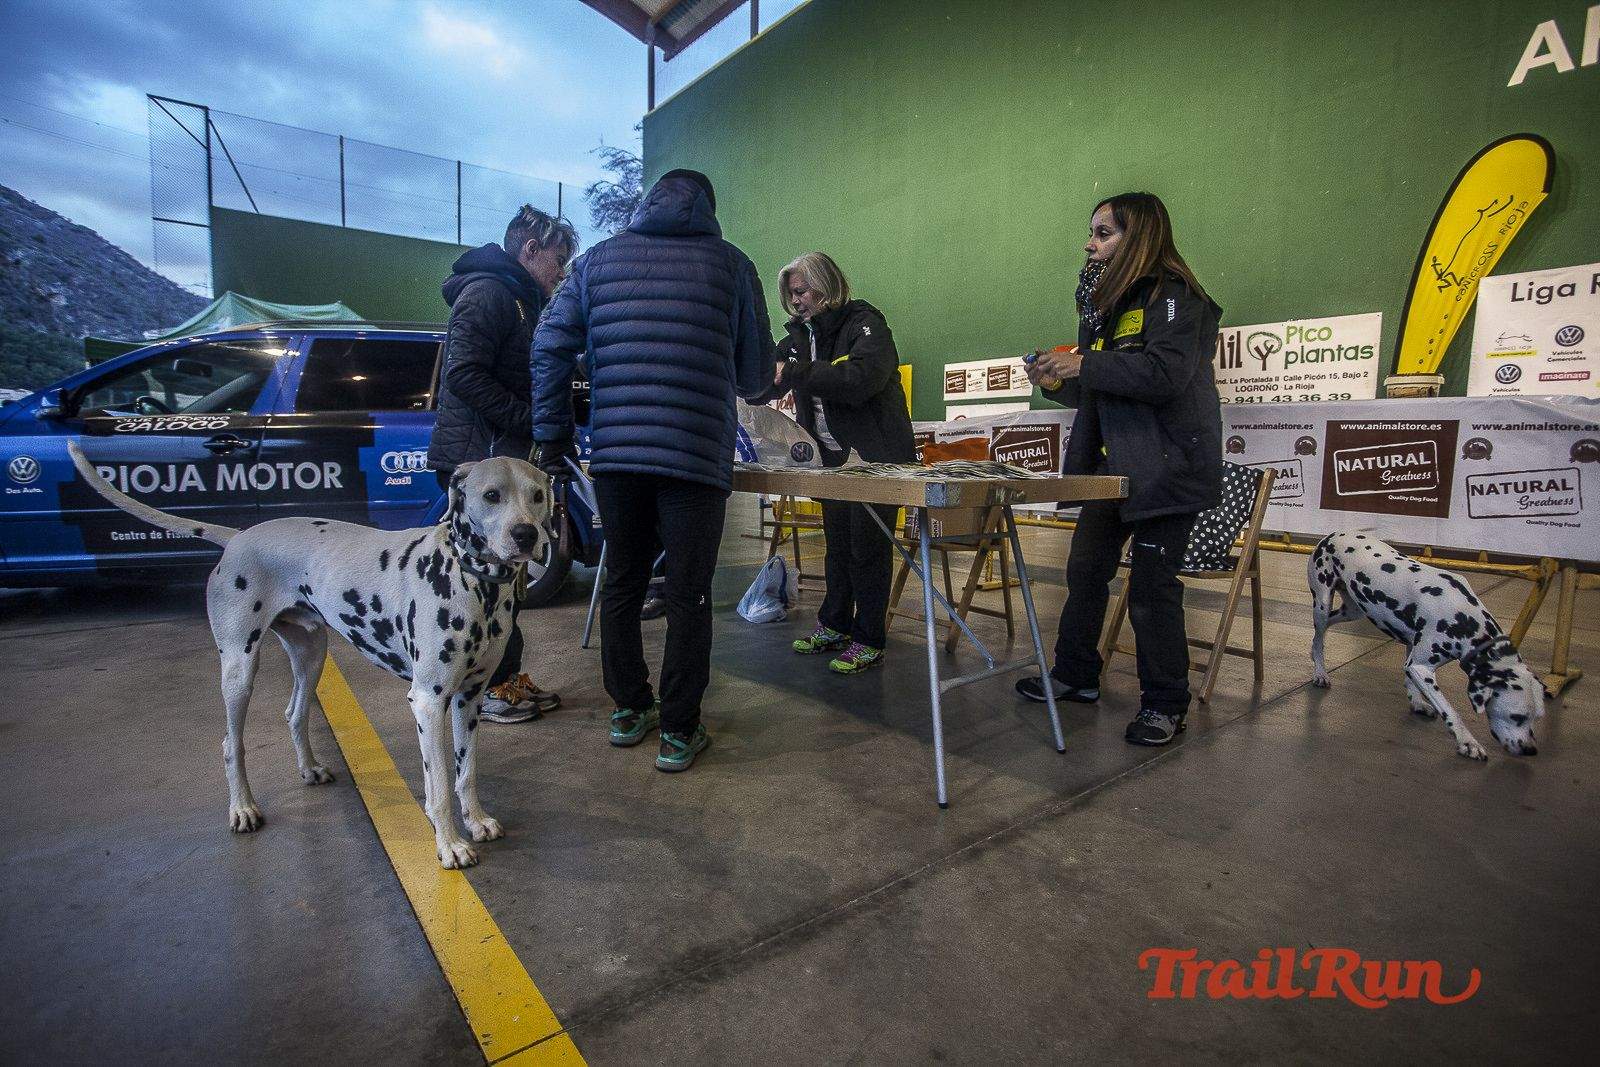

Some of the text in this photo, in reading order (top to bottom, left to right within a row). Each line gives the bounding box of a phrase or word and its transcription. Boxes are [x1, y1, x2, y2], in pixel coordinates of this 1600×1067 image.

[1510, 281, 1577, 305] Liga
[1286, 325, 1332, 344] Pico
[1284, 344, 1374, 370] plantas
[1240, 376, 1273, 384] Portalada
[1304, 372, 1326, 381] Picón
[1328, 372, 1340, 380] 15,
[1342, 371, 1361, 379] Bajo
[1235, 383, 1279, 393] LOGROÑO
[1295, 383, 1315, 391] Rioja
[1234, 392, 1352, 404] 941 43 36 39
[114, 421, 229, 432] CALOCO
[1340, 422, 1442, 431] www.animalstore.es
[1472, 422, 1600, 432] www.animalstore.es
[998, 446, 1048, 463] NATURAL
[1338, 451, 1432, 473] NATURAL
[97, 461, 343, 494] RIOJA MOTOR
[385, 475, 411, 485] Audi
[1380, 470, 1431, 486] Greatness
[1471, 478, 1574, 497] NATURAL
[1517, 495, 1574, 510] Greatness
[1525, 519, 1549, 527] Quality
[111, 531, 146, 541] Centro
[150, 531, 162, 539] de
